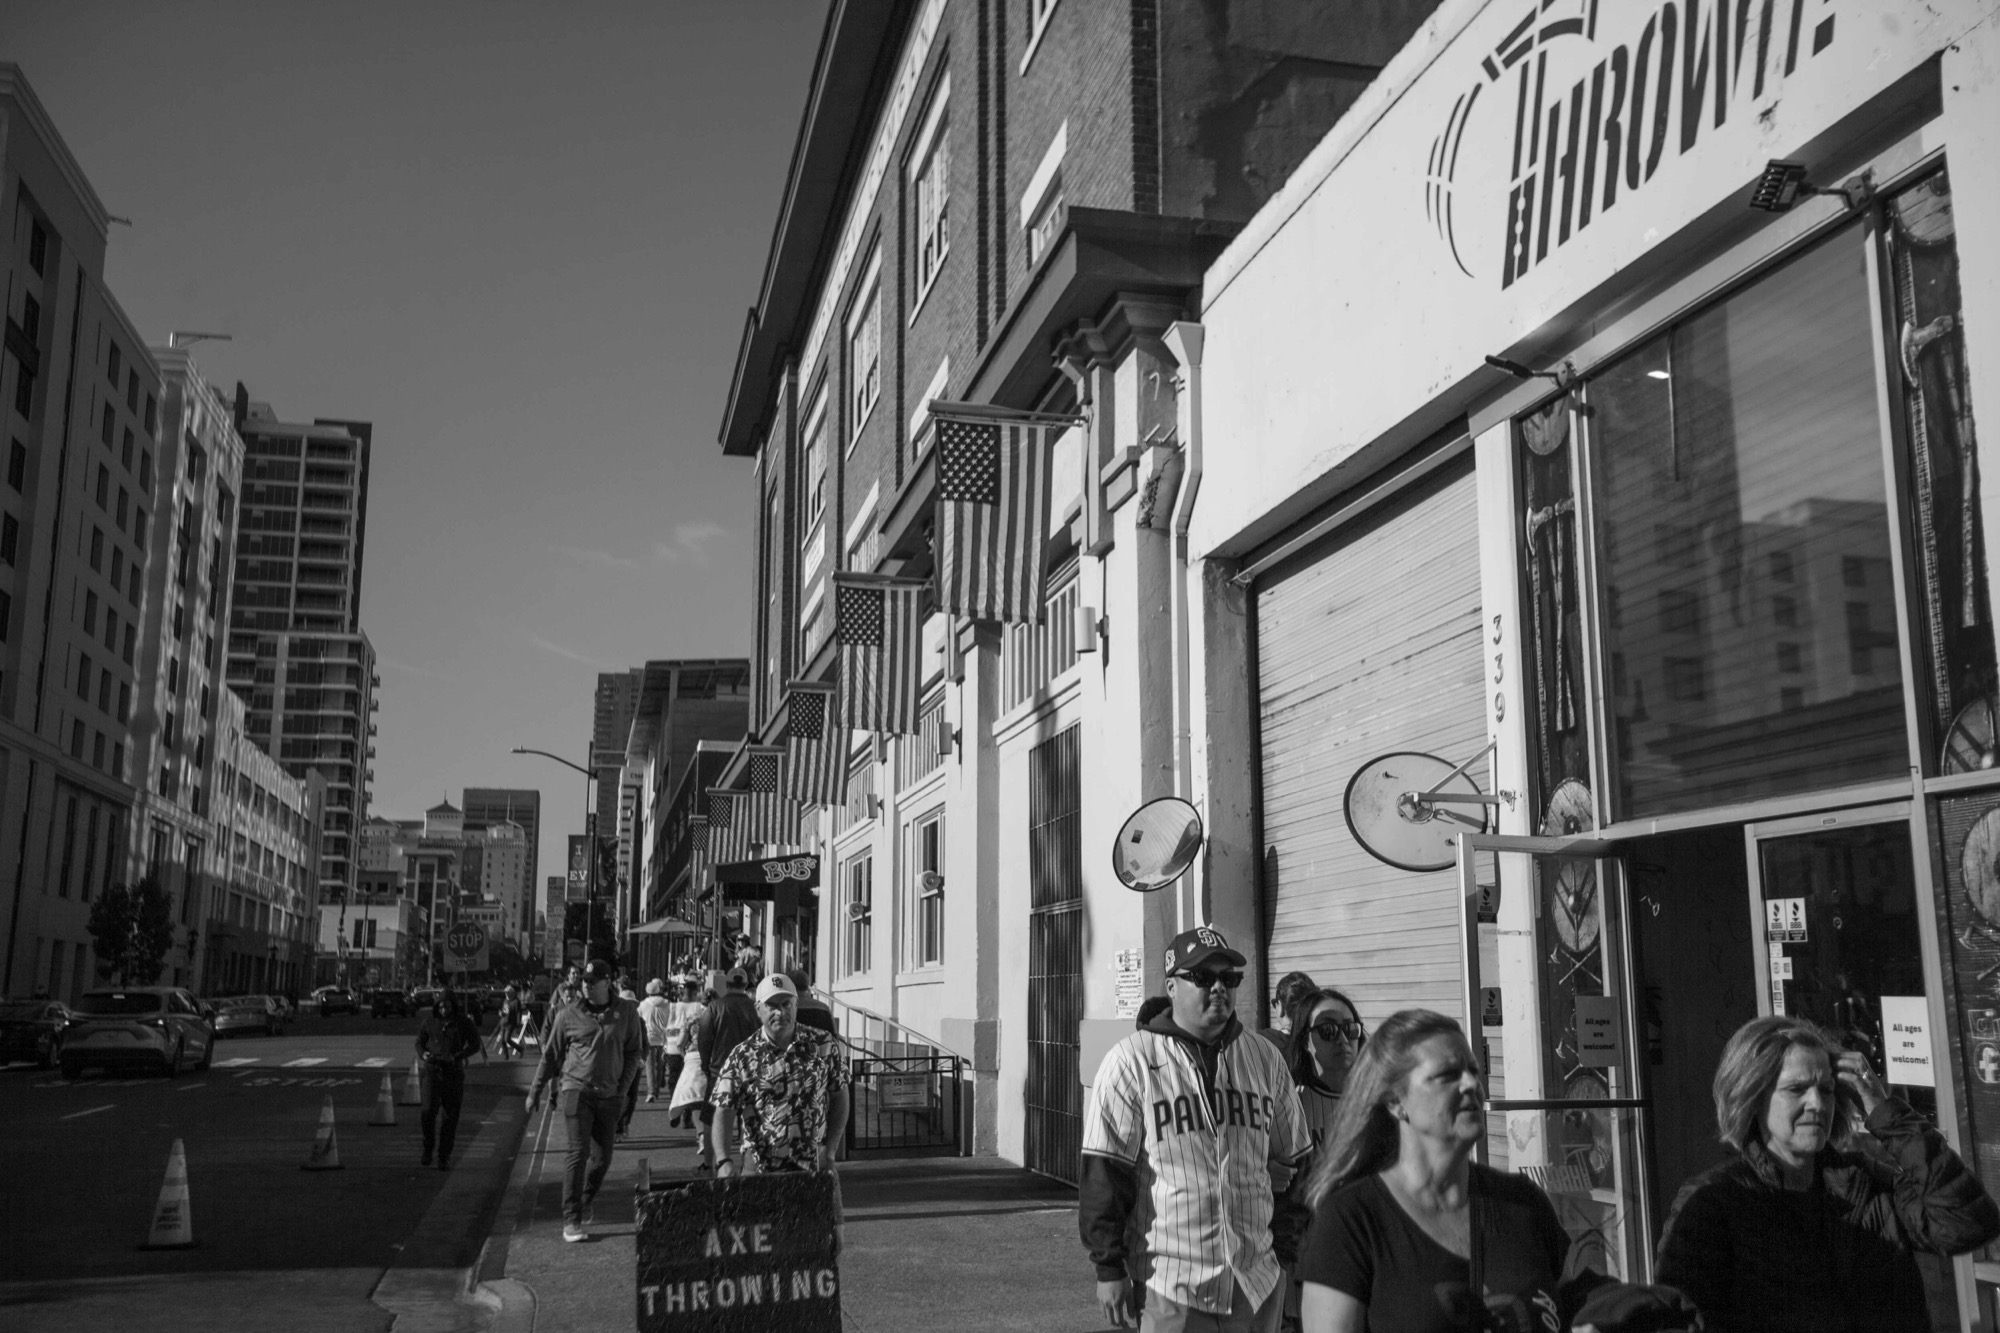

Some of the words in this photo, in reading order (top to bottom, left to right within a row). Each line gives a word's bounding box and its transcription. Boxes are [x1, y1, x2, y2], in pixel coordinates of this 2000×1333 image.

[1493, 613, 1506, 723] 339
[569, 870, 588, 881] EV
[450, 933, 483, 949] STOP
[1893, 1023, 1904, 1032] All
[1905, 1026, 1922, 1034] ages
[1892, 1056, 1929, 1065] welcome!
[242, 1078, 363, 1088] STOP
[1153, 1088, 1275, 1142] PADRES
[705, 1223, 772, 1258] AXE
[641, 1269, 836, 1316] THROWING
